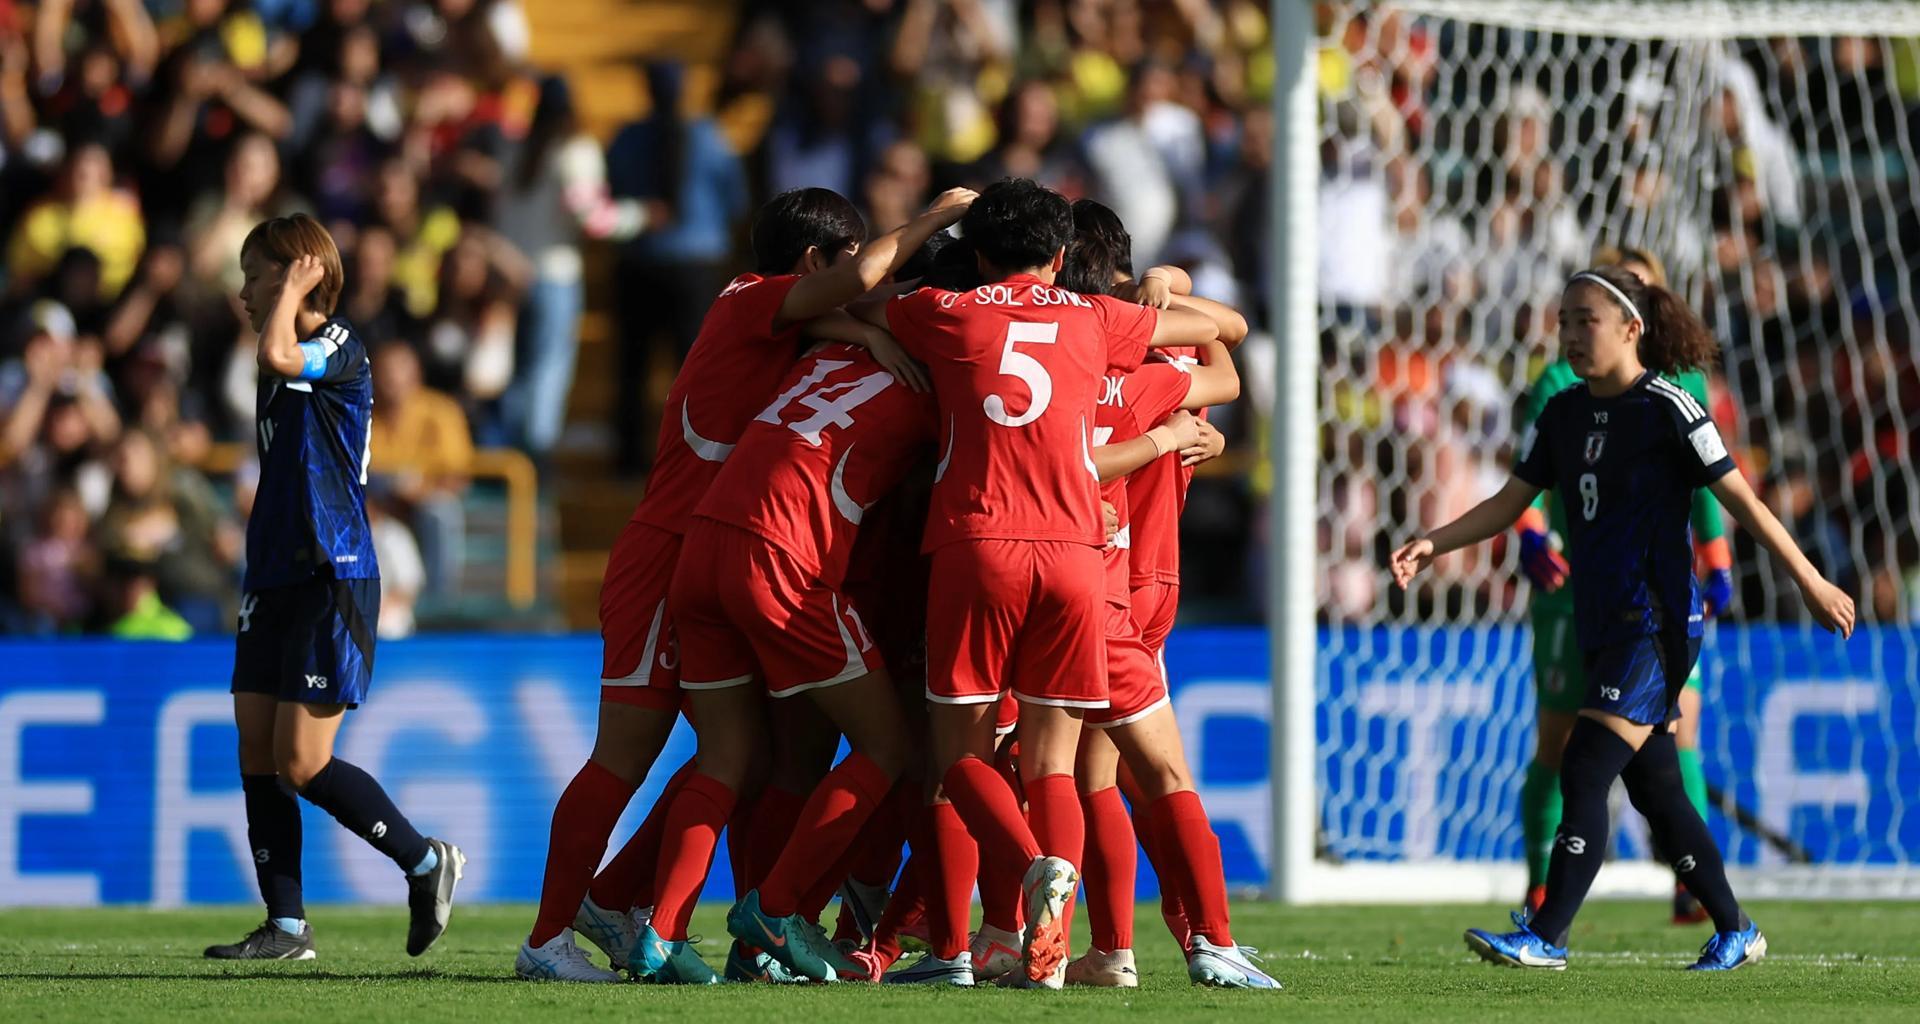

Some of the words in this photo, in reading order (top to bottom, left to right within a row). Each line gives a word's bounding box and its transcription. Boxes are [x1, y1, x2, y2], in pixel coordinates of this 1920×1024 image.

[975, 284, 1024, 307] SOL
[755, 358, 895, 448] 14
[983, 321, 1060, 428] 5
